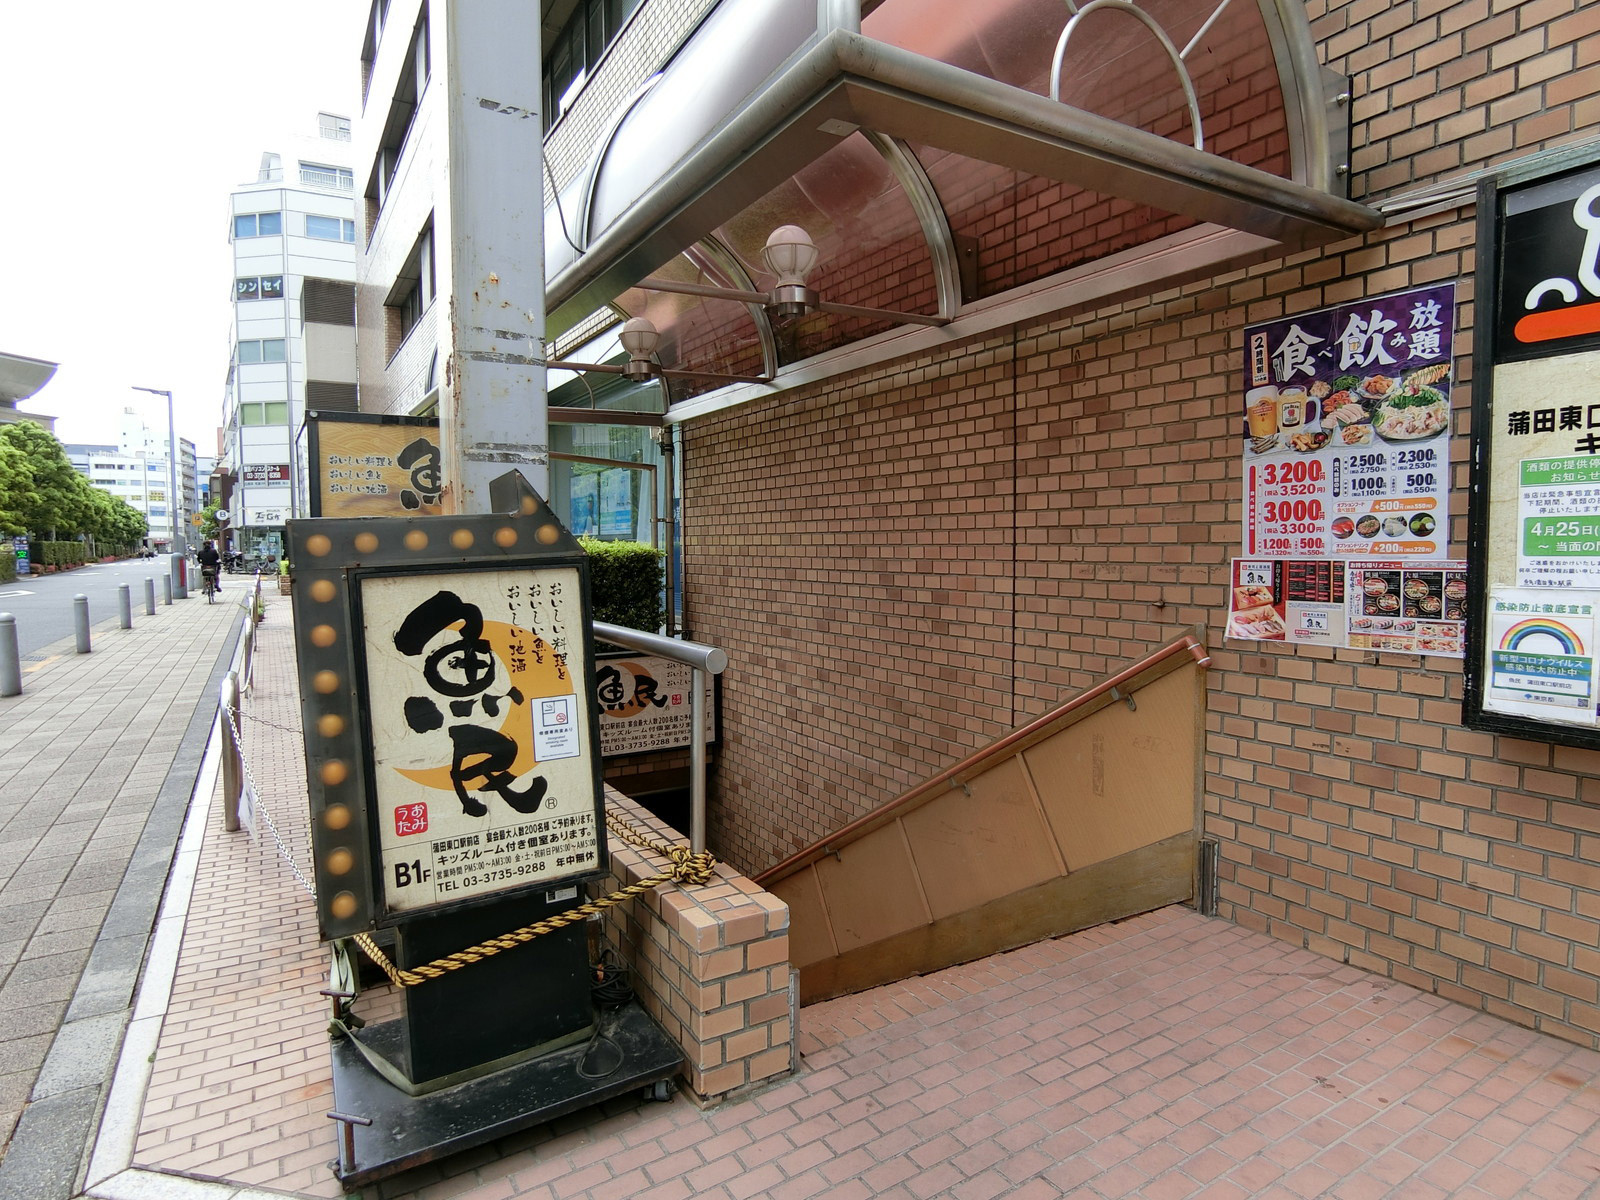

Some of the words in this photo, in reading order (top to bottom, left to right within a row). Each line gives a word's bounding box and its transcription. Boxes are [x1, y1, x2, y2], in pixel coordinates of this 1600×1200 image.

[238, 279, 281, 293] シンセイ
[329, 455, 393, 467] おいしい料理と
[1526, 458, 1600, 472] 酒類の提供停
[329, 469, 381, 480] おいしい魚と
[1551, 471, 1600, 482] お知らせ
[330, 483, 388, 494] おいしい地酒
[1495, 602, 1592, 615] 感染防止徹底宣言
[507, 585, 527, 673] おいしい地酒
[528, 584, 547, 664] おいしい魚と
[549, 582, 568, 680] おいしい料理と
[1499, 654, 1584, 668] 新型コロナウイルス
[1505, 663, 1577, 677] 感染拡大防止中
[392, 590, 548, 818] 魚民
[433, 835, 480, 853] 蒲田東口駅前店
[486, 821, 550, 843] 宴会最大人数200名様
[552, 813, 594, 829] ご予約承ります。
[437, 827, 592, 866] キッズルーム付き個室あります。
[437, 880, 459, 893] TEL
[463, 861, 546, 887] 03-3735-9288
[556, 851, 595, 868] 年中無休
